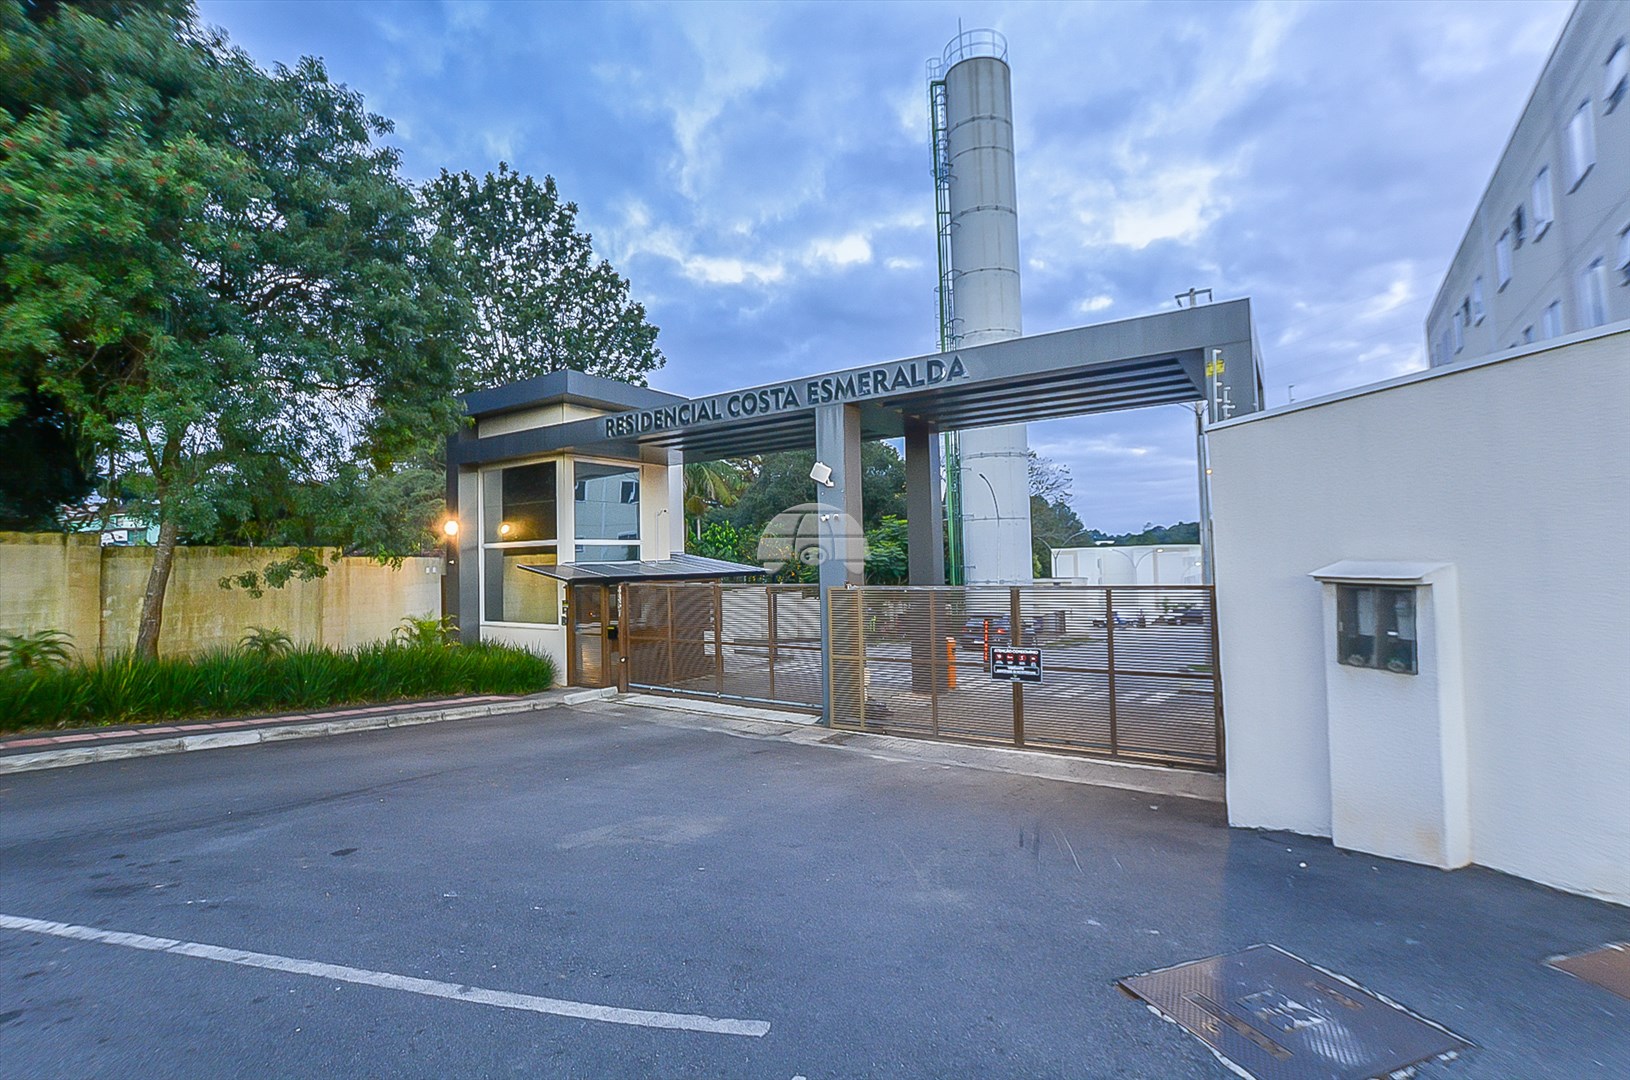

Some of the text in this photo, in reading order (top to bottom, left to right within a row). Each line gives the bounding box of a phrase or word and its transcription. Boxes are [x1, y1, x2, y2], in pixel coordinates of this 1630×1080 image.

[605, 354, 968, 438] RESIDENCIAL COSTA ESMERALDA
